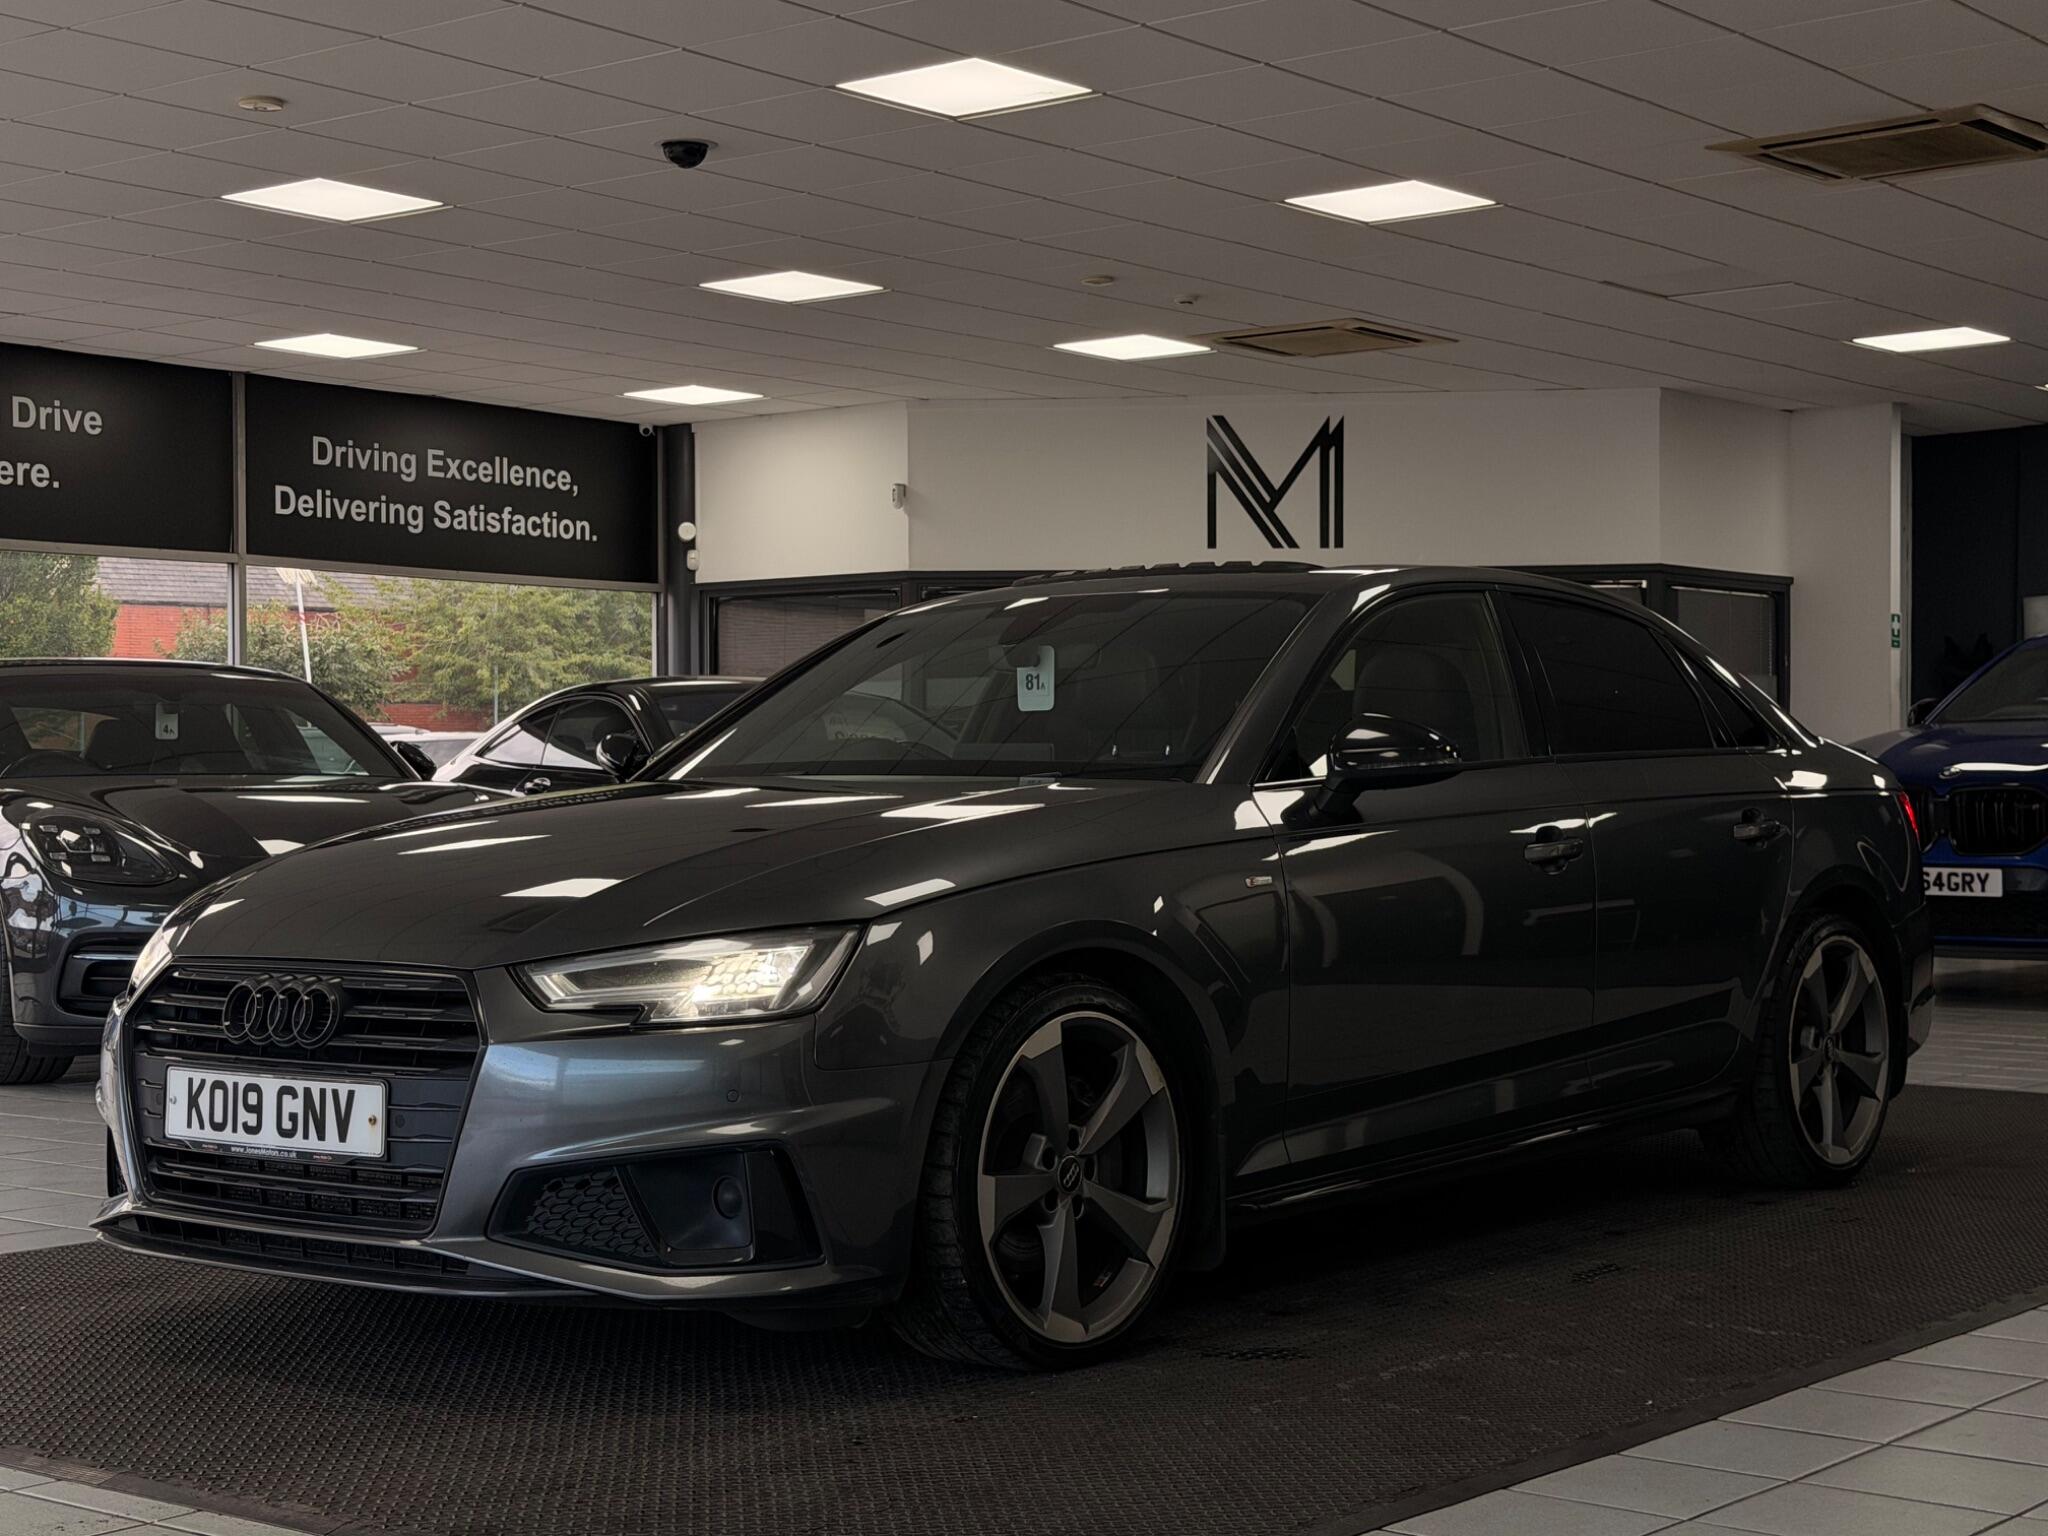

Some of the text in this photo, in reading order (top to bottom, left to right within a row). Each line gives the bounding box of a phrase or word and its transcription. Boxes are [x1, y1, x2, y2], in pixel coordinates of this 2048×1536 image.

[12, 395, 103, 436] Drive
[0, 460, 60, 489] ere.
[312, 435, 578, 497] Driving Excellence,
[274, 485, 598, 542] Delivering Satisfaction.
[276, 1085, 356, 1143] GNV
